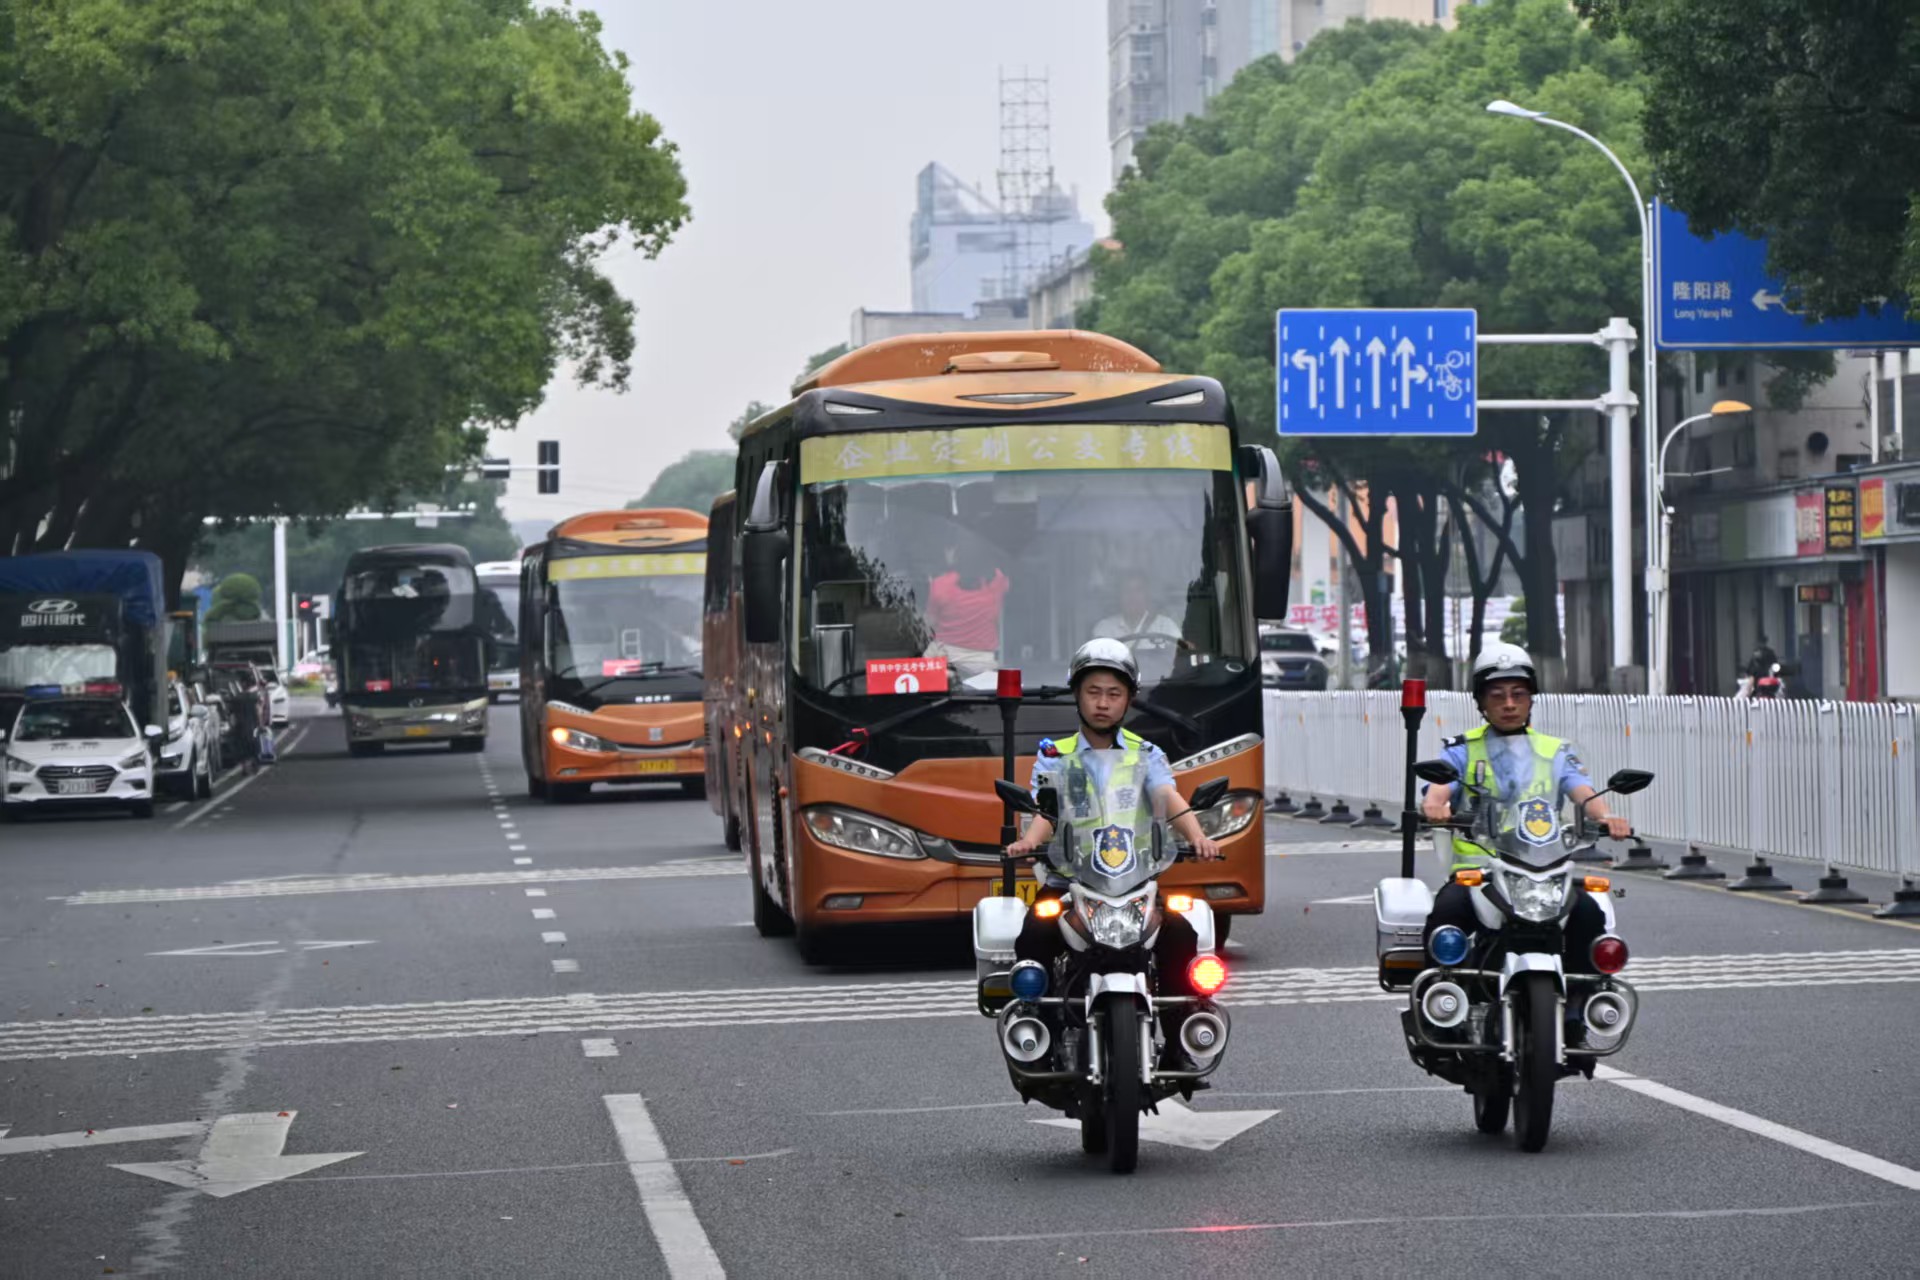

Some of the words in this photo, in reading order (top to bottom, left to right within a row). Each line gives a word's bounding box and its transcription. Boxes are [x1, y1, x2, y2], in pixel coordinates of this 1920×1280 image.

[1672, 281, 1731, 301] 隆阳路
[1674, 307, 1695, 320] Long
[1697, 307, 1720, 320] Yang
[1721, 307, 1733, 318] Rd
[835, 429, 1202, 471] 企业定制公交专线
[21, 612, 86, 627] 四川现代
[1116, 787, 1137, 809] 察
